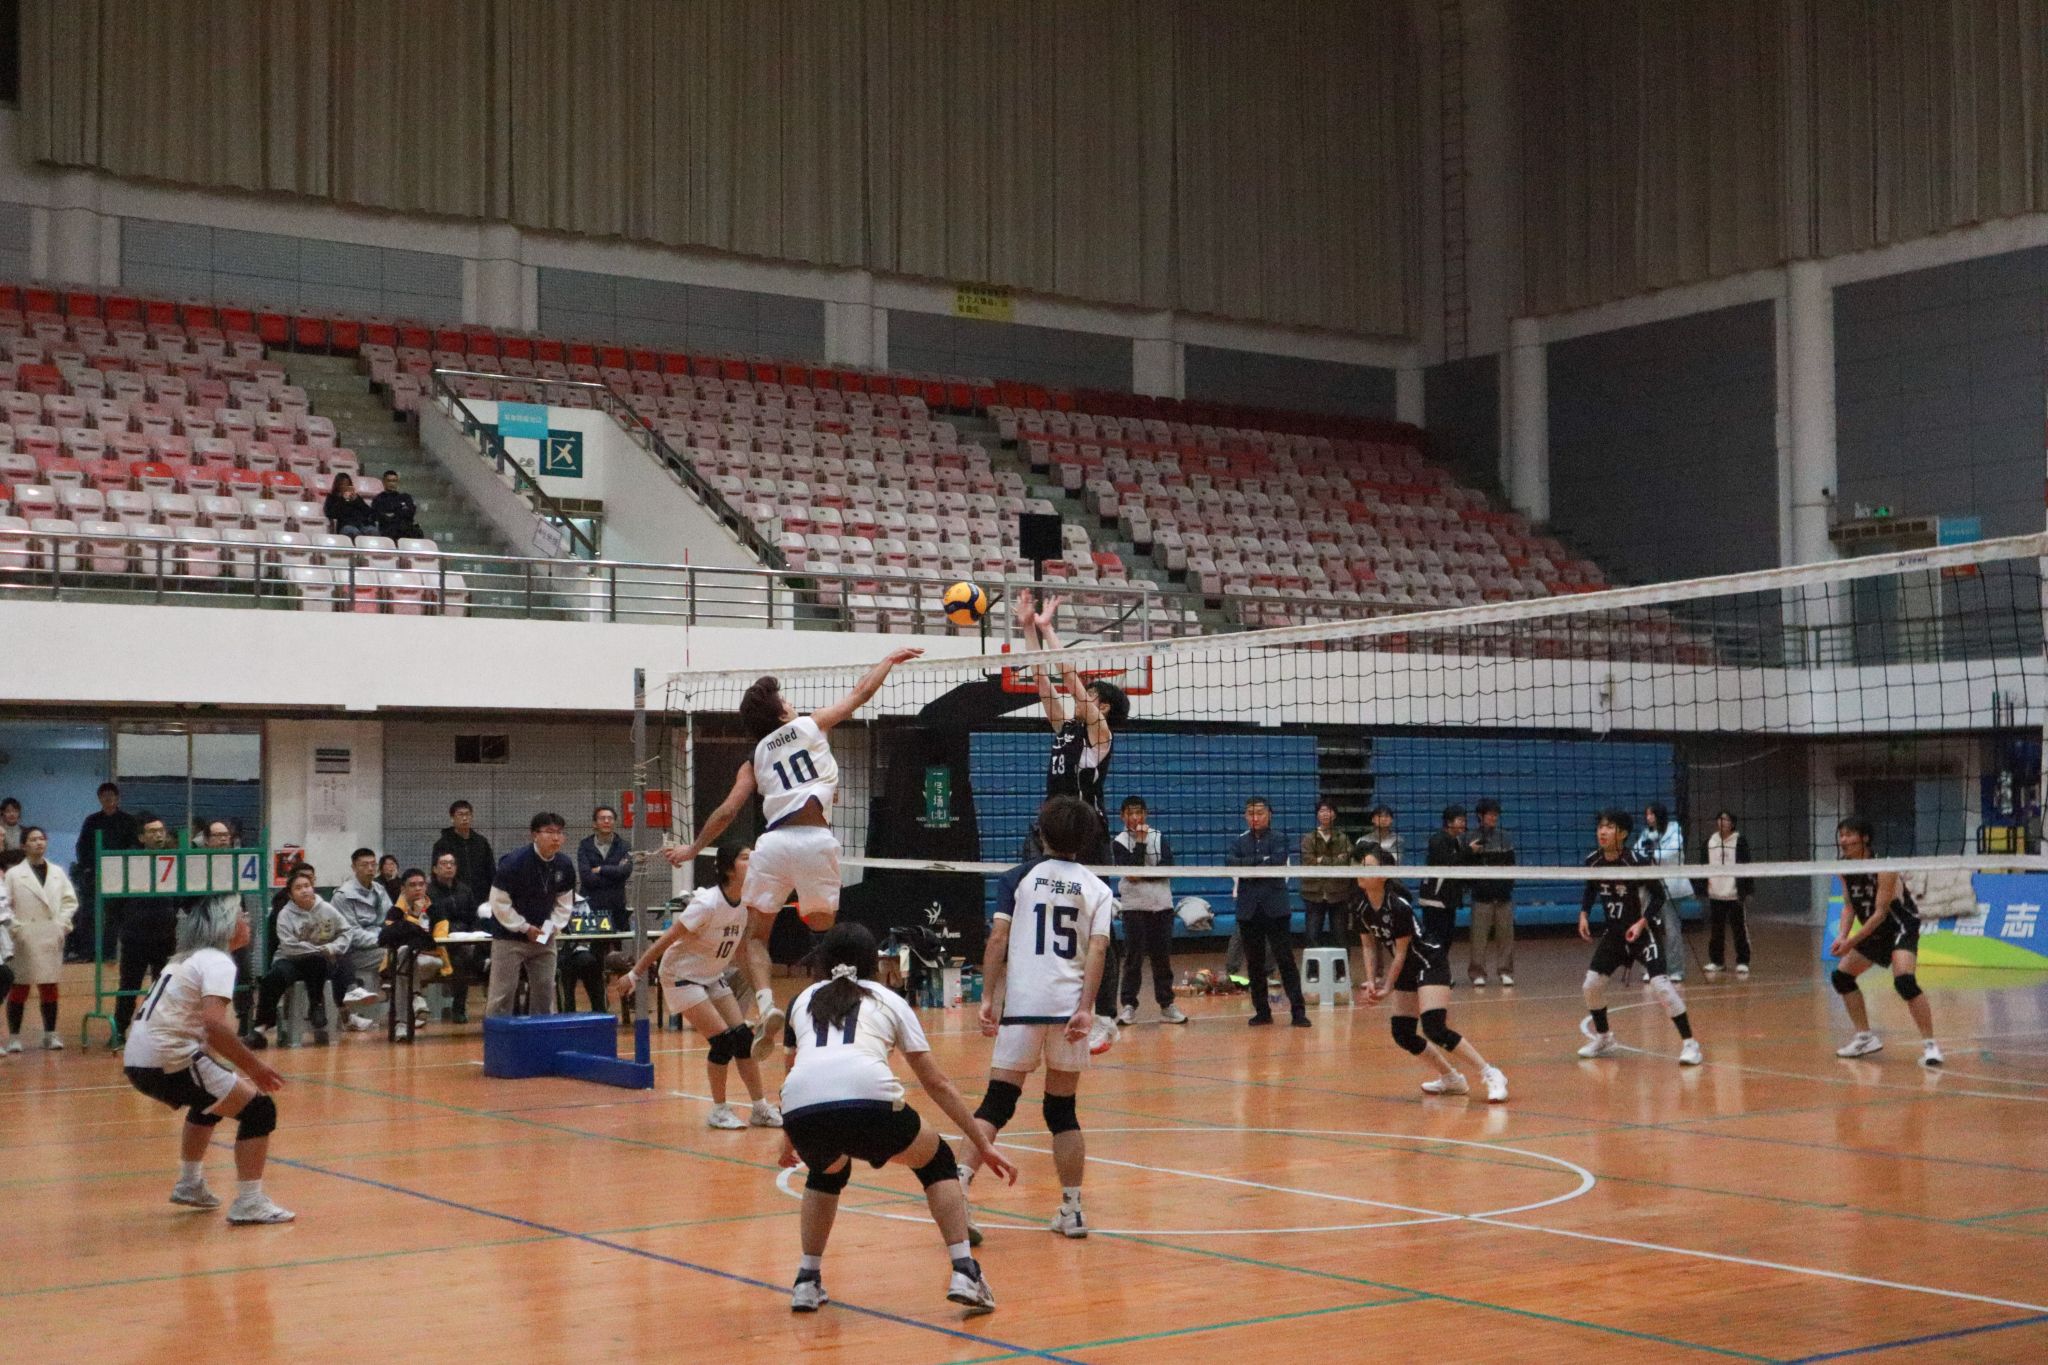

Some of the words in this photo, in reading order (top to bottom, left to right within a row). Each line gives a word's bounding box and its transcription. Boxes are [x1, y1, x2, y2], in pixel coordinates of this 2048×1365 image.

[546, 437, 577, 470] 区
[773, 749, 819, 790] 10
[158, 856, 175, 883] 7
[241, 856, 257, 881] 4
[1034, 878, 1082, 895] 严浩源
[1607, 902, 1623, 919] 27
[571, 917, 582, 931] 7
[600, 917, 611, 931] 4
[1033, 903, 1080, 960] 15
[716, 940, 734, 959] 10
[1642, 943, 1659, 962] 27
